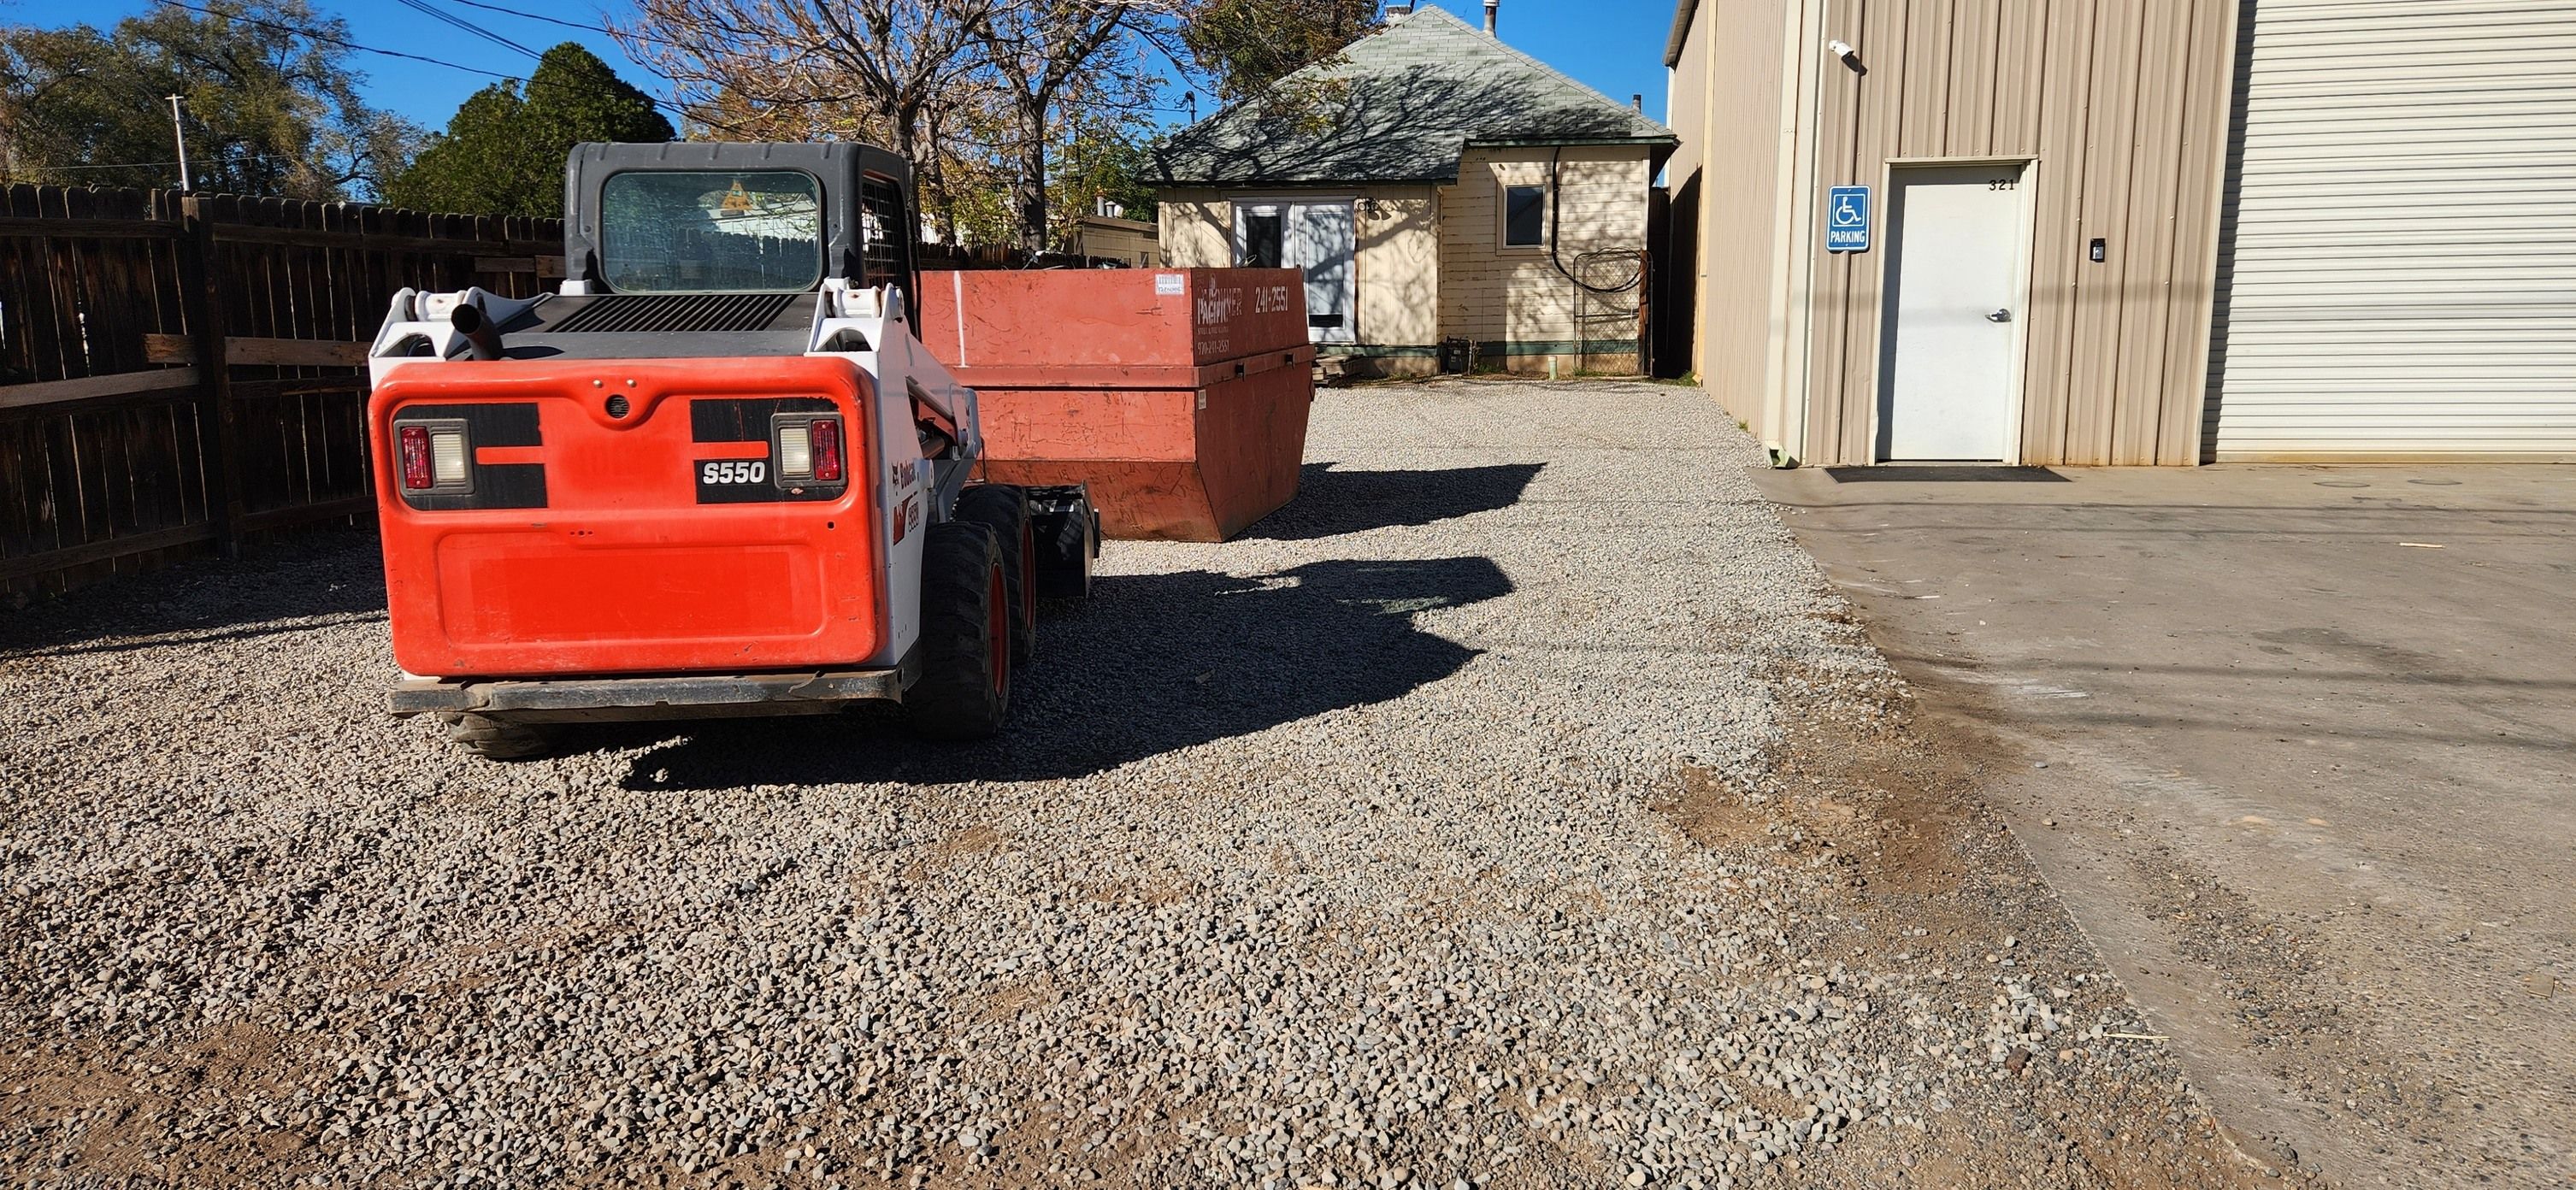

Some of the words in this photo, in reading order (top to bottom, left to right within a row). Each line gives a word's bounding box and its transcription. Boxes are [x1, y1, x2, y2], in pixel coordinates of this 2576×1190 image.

[1989, 179, 2015, 191] 321
[1830, 230, 1865, 244] PARKING
[702, 461, 766, 485] S550
[900, 460, 916, 490] Bobcat
